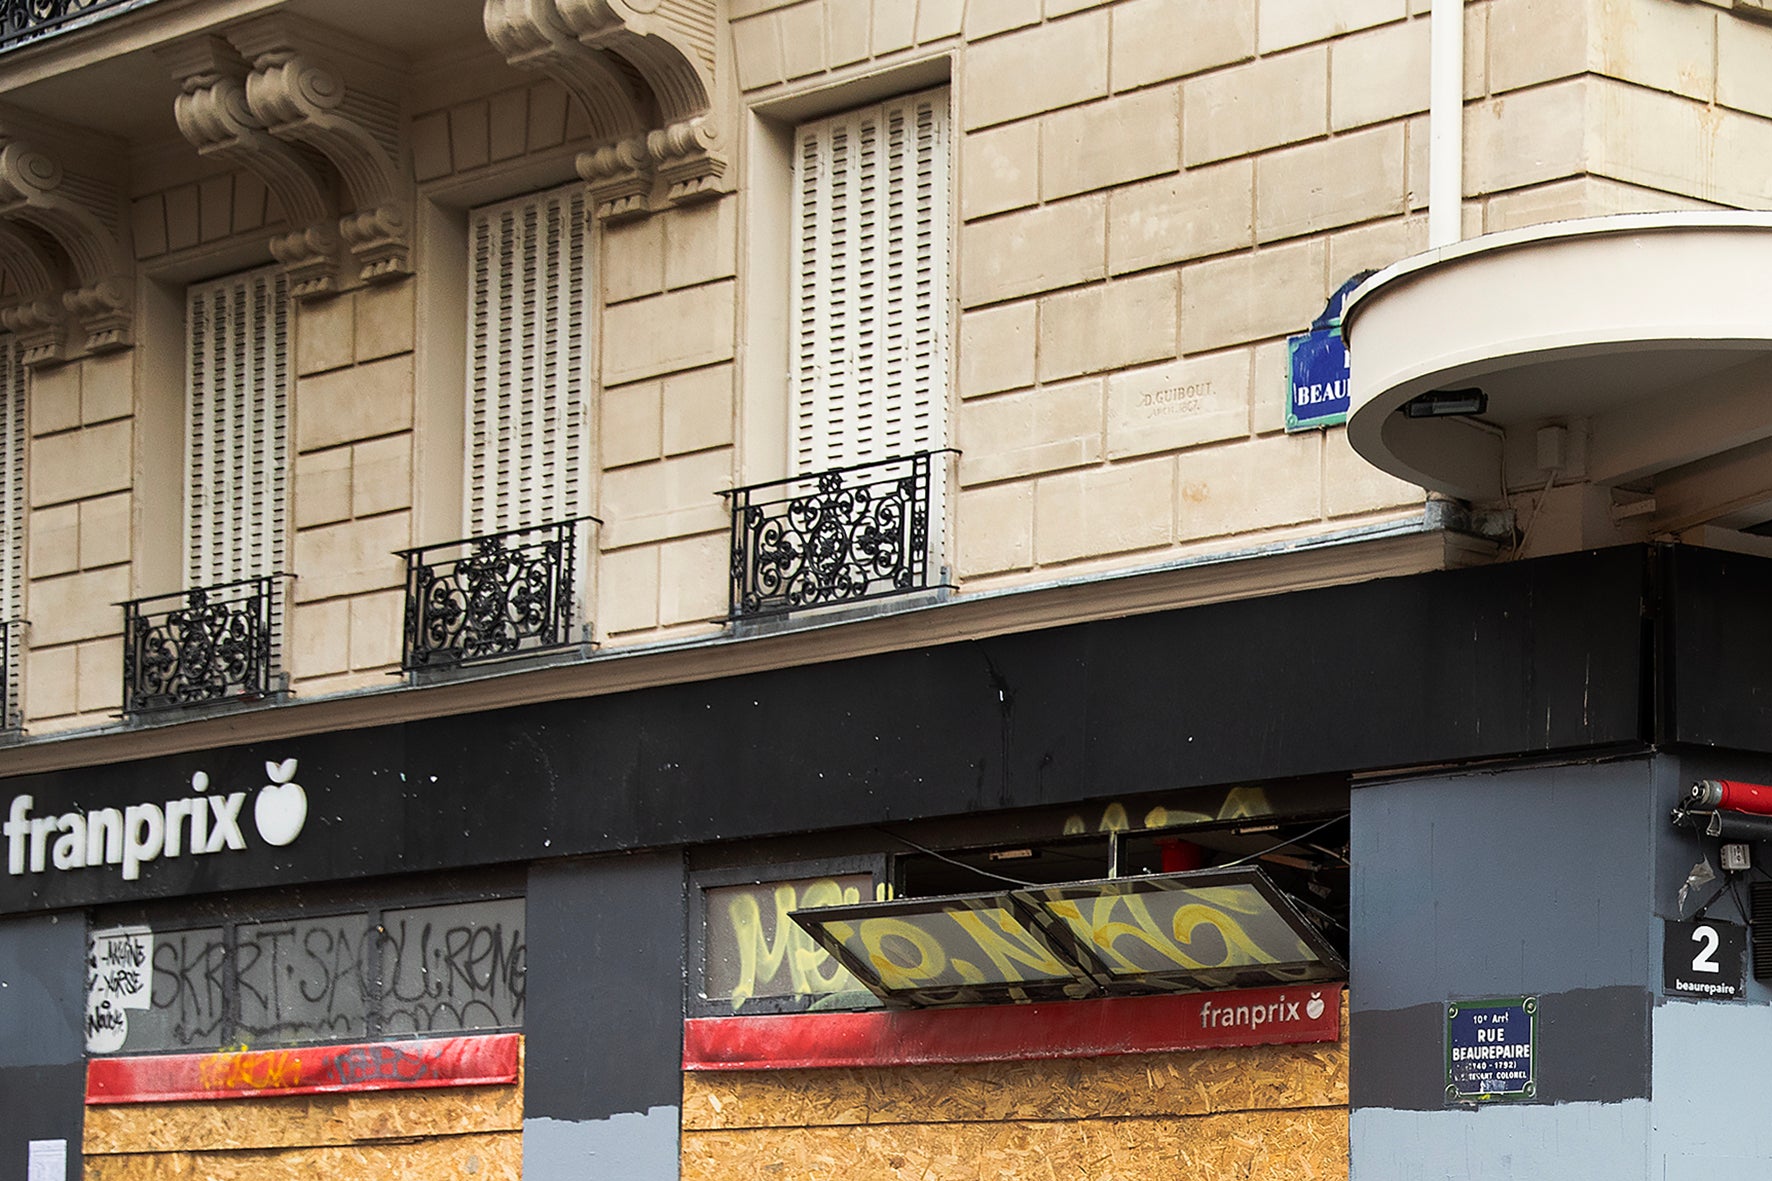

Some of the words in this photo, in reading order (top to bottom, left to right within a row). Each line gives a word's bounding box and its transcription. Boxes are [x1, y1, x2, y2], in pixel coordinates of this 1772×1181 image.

[1297, 377, 1350, 406] BEAU
[3, 771, 248, 881] franprix
[1691, 925, 1720, 973] 2
[1675, 978, 1736, 996] beaurepaire
[1199, 994, 1301, 1031] franprix
[1477, 1028, 1505, 1042] RUE
[1452, 1044, 1531, 1061] BEAUREPAIRE
